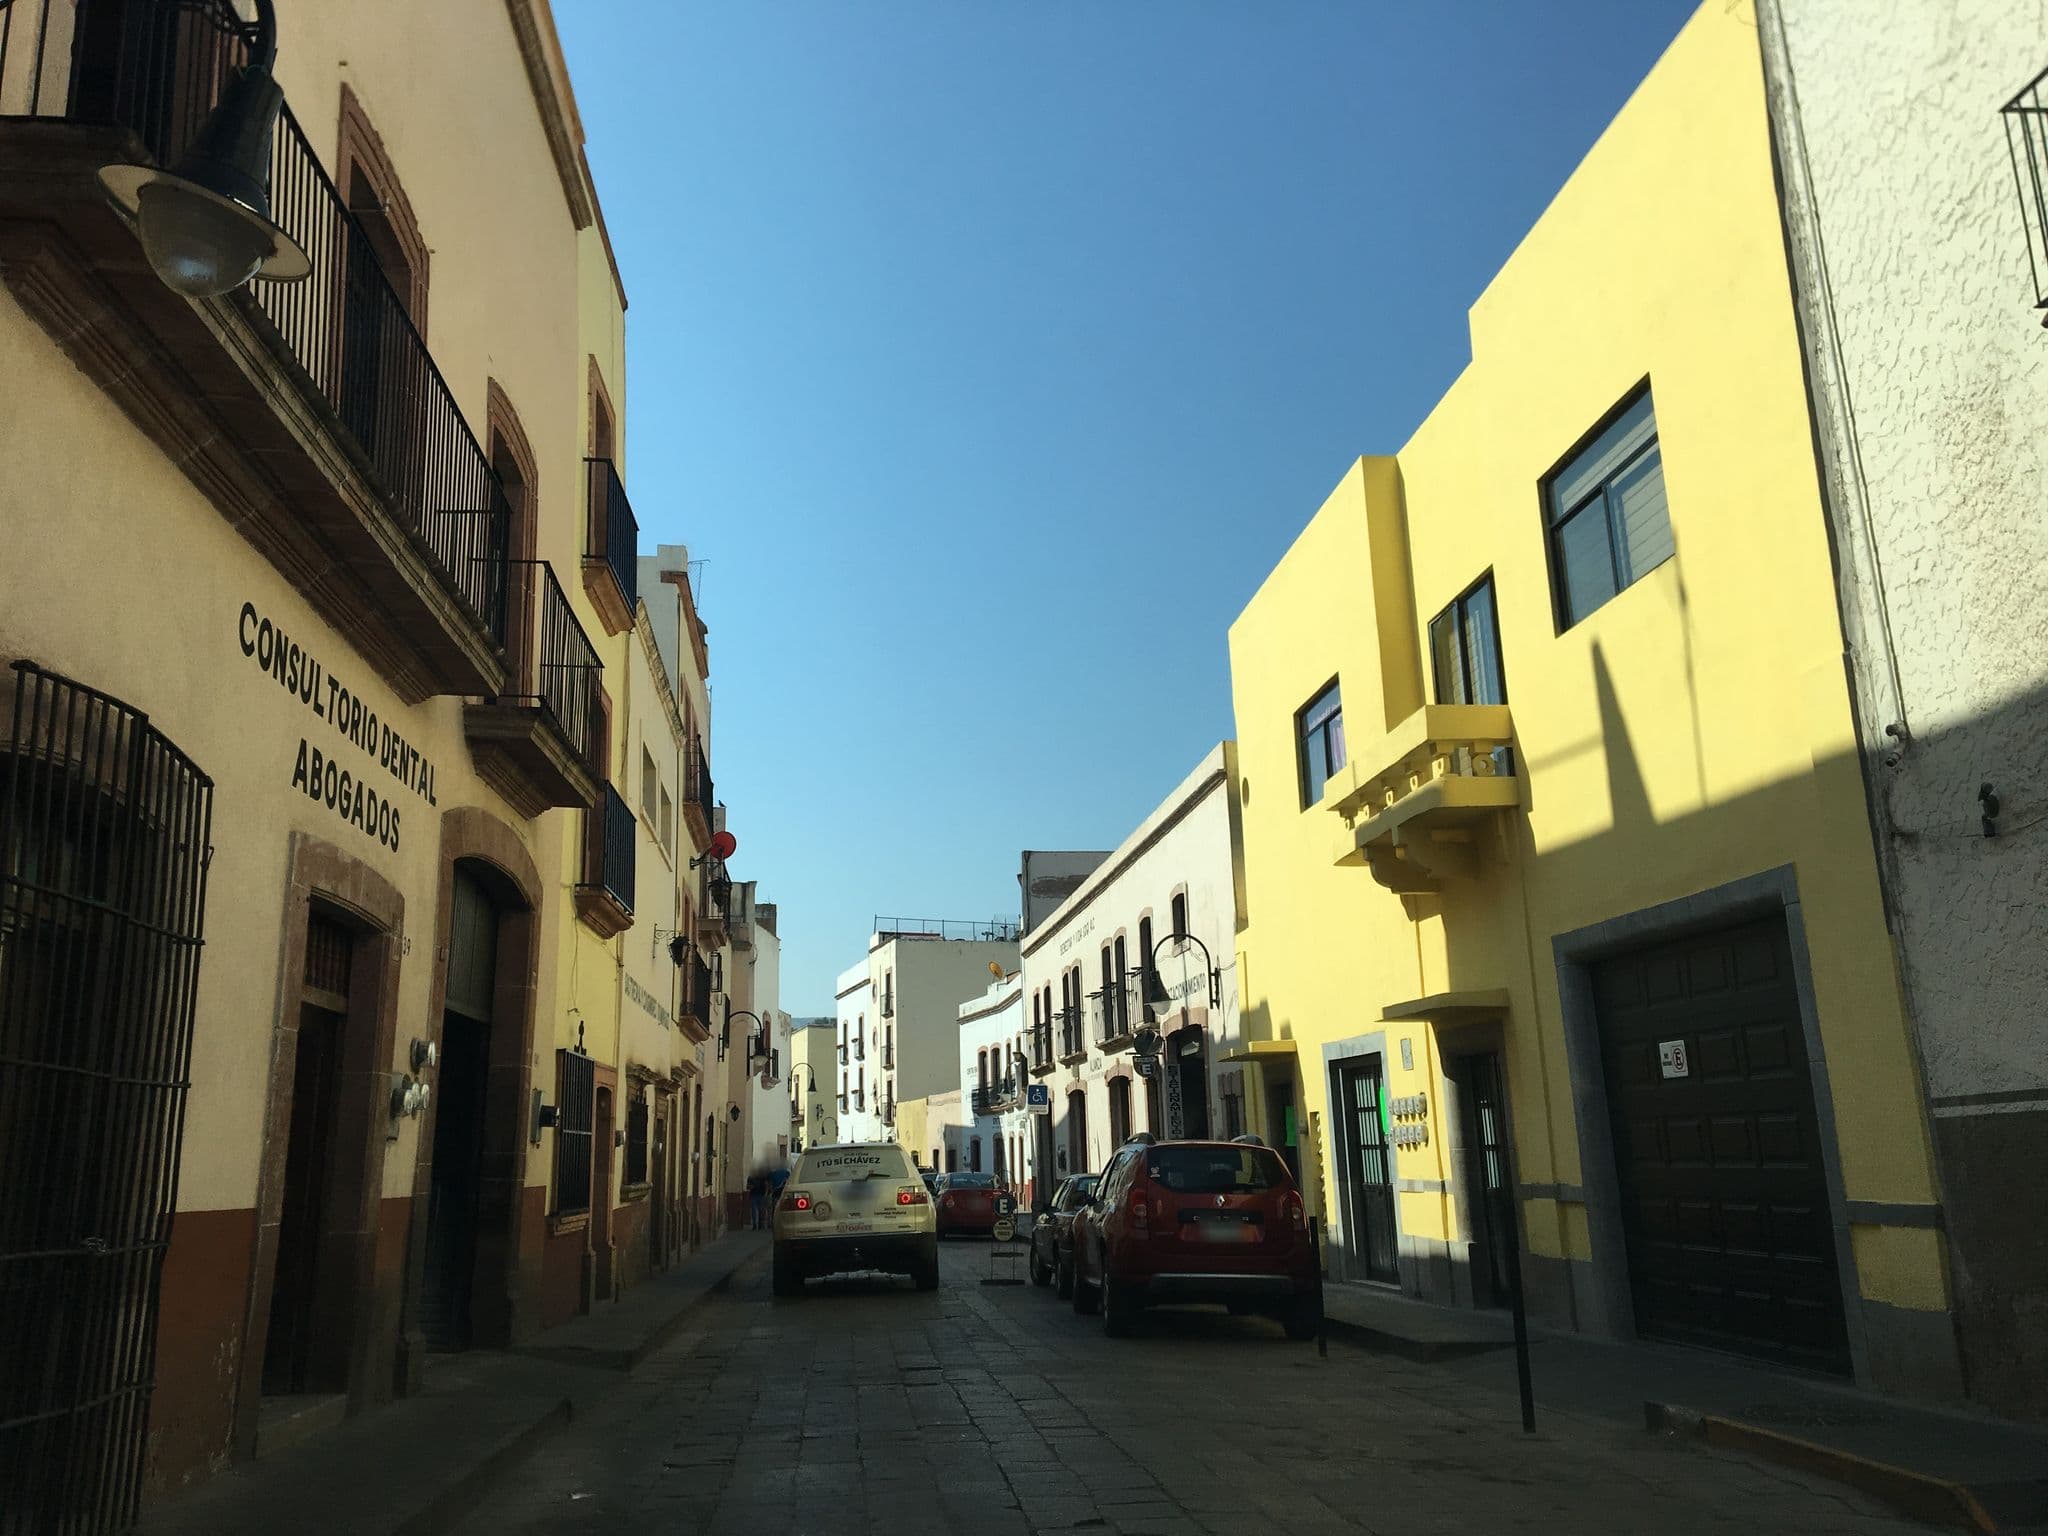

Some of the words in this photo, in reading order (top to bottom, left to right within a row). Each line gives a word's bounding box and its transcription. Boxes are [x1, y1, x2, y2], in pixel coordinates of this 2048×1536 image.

[239, 602, 378, 757] CONSULTORIO
[380, 722, 437, 807] DENTAL
[292, 738, 401, 853] ABOGADOS
[1000, 1198, 1009, 1214] E
